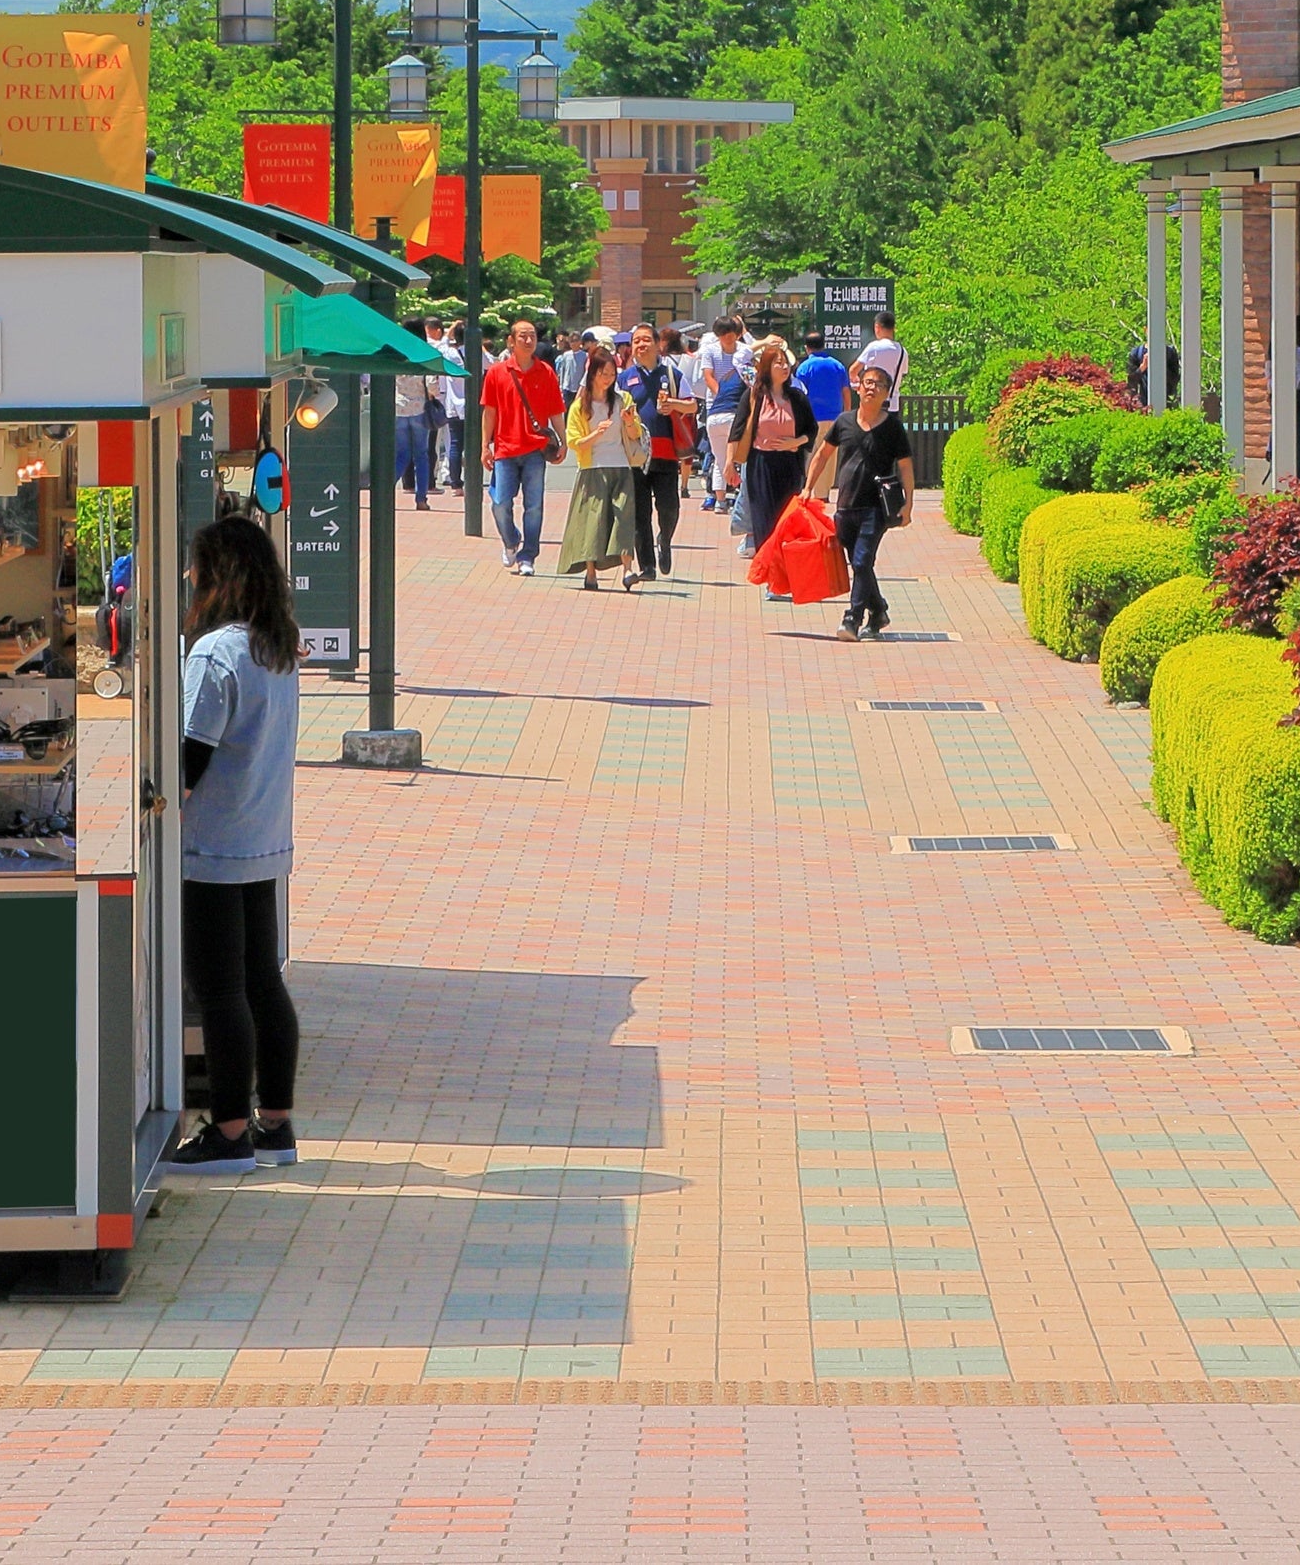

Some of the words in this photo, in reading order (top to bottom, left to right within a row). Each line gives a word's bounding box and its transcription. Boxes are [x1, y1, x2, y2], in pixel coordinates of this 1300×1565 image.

[1, 44, 123, 70] GOTEMBA
[5, 83, 116, 101] PREMIUM
[7, 115, 112, 132] OUTLETS
[257, 139, 317, 152] GOTEMBA
[259, 159, 314, 168] PREMIUM
[260, 175, 313, 183] OUTLETS
[371, 174, 417, 183] OUTLET
[737, 300, 761, 309] STAR
[296, 541, 341, 552] BATEAU
[325, 639, 337, 650] P4
